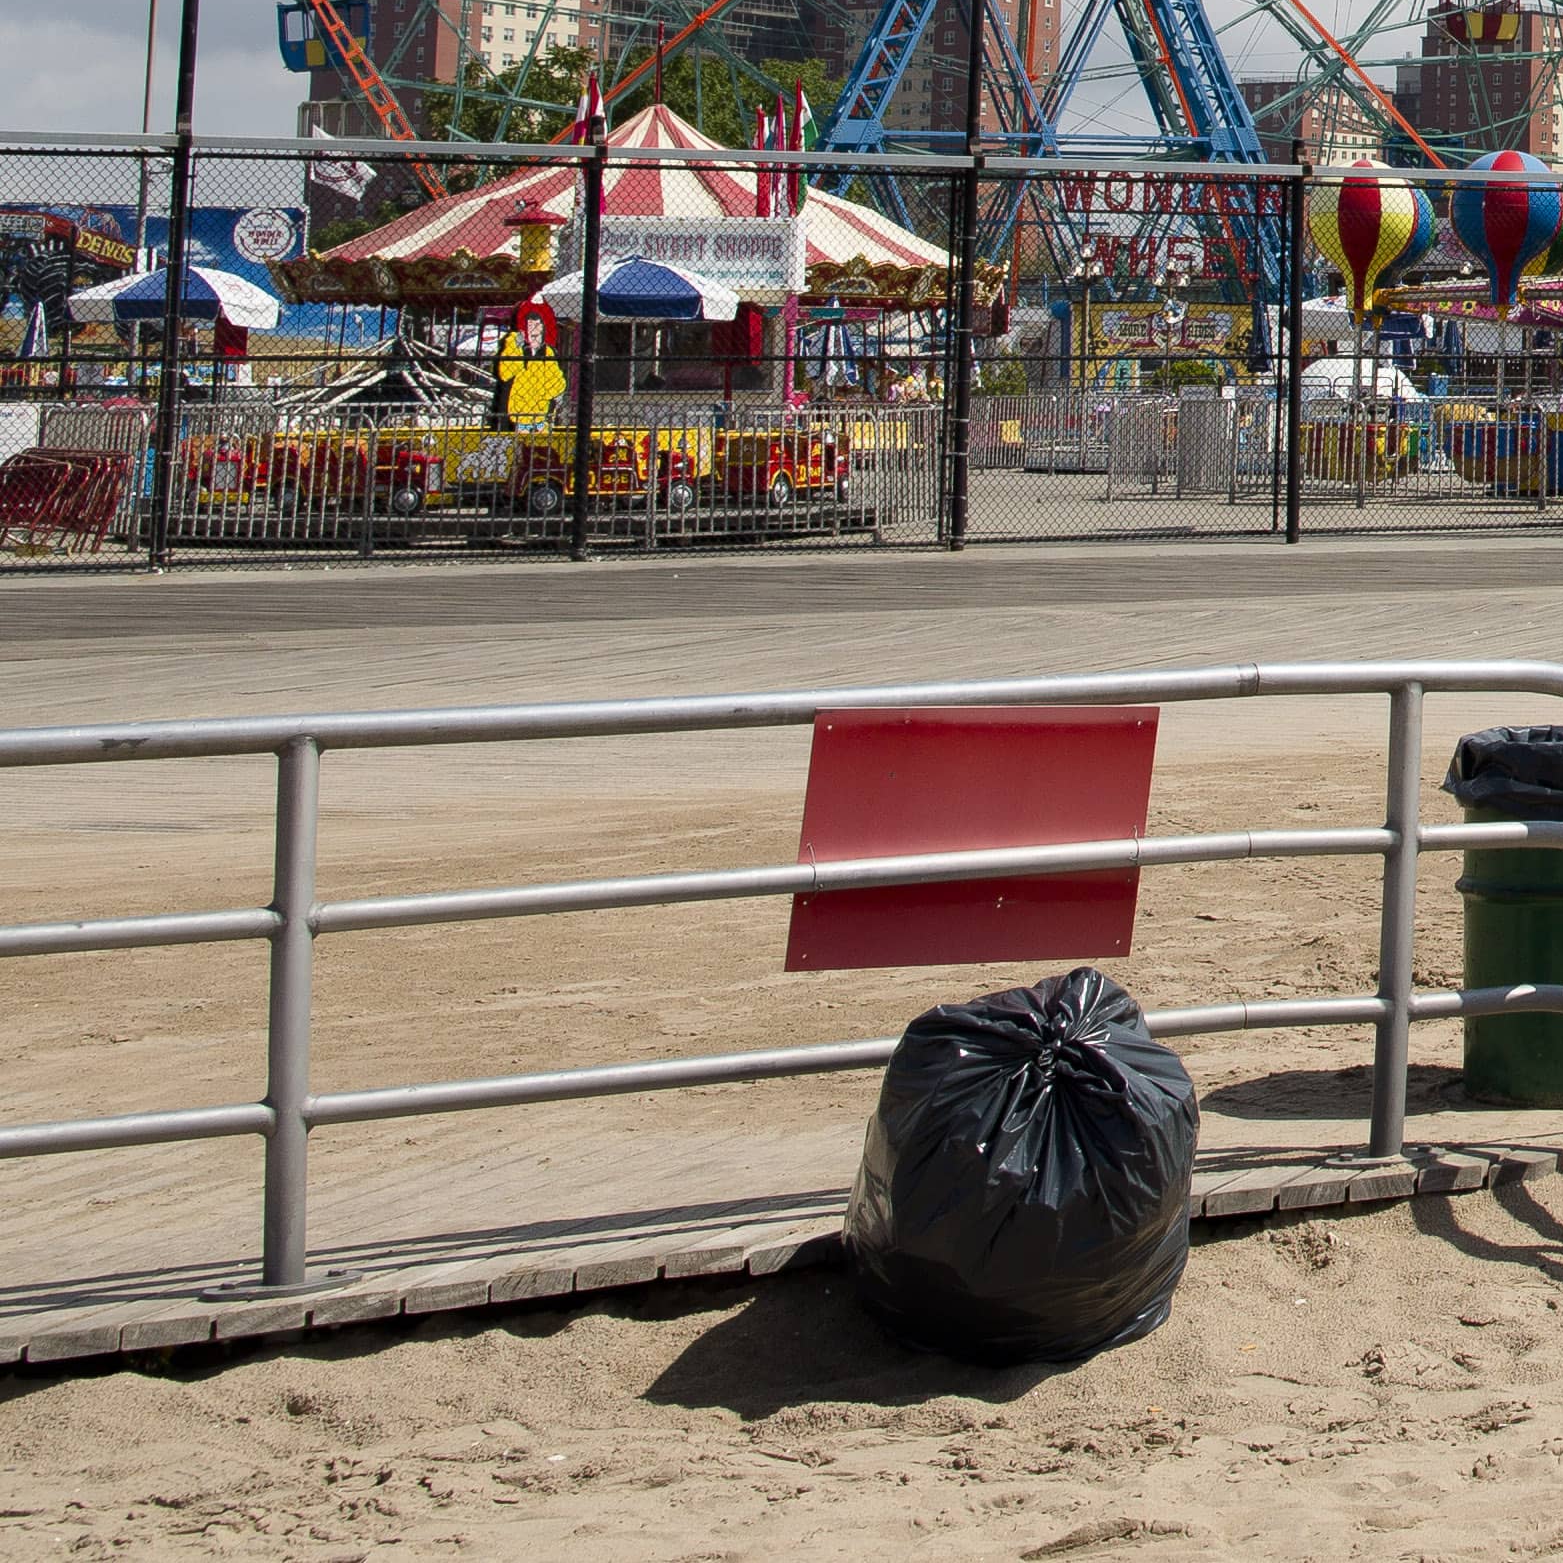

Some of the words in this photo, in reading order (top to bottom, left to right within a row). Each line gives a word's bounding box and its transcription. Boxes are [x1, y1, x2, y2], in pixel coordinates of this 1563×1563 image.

[1060, 170, 1283, 215] WONDER
[75, 230, 137, 266] DENOS
[644, 235, 705, 260] SWEET
[715, 236, 784, 261] SHOPPE
[1081, 234, 1260, 281] WHEEL
